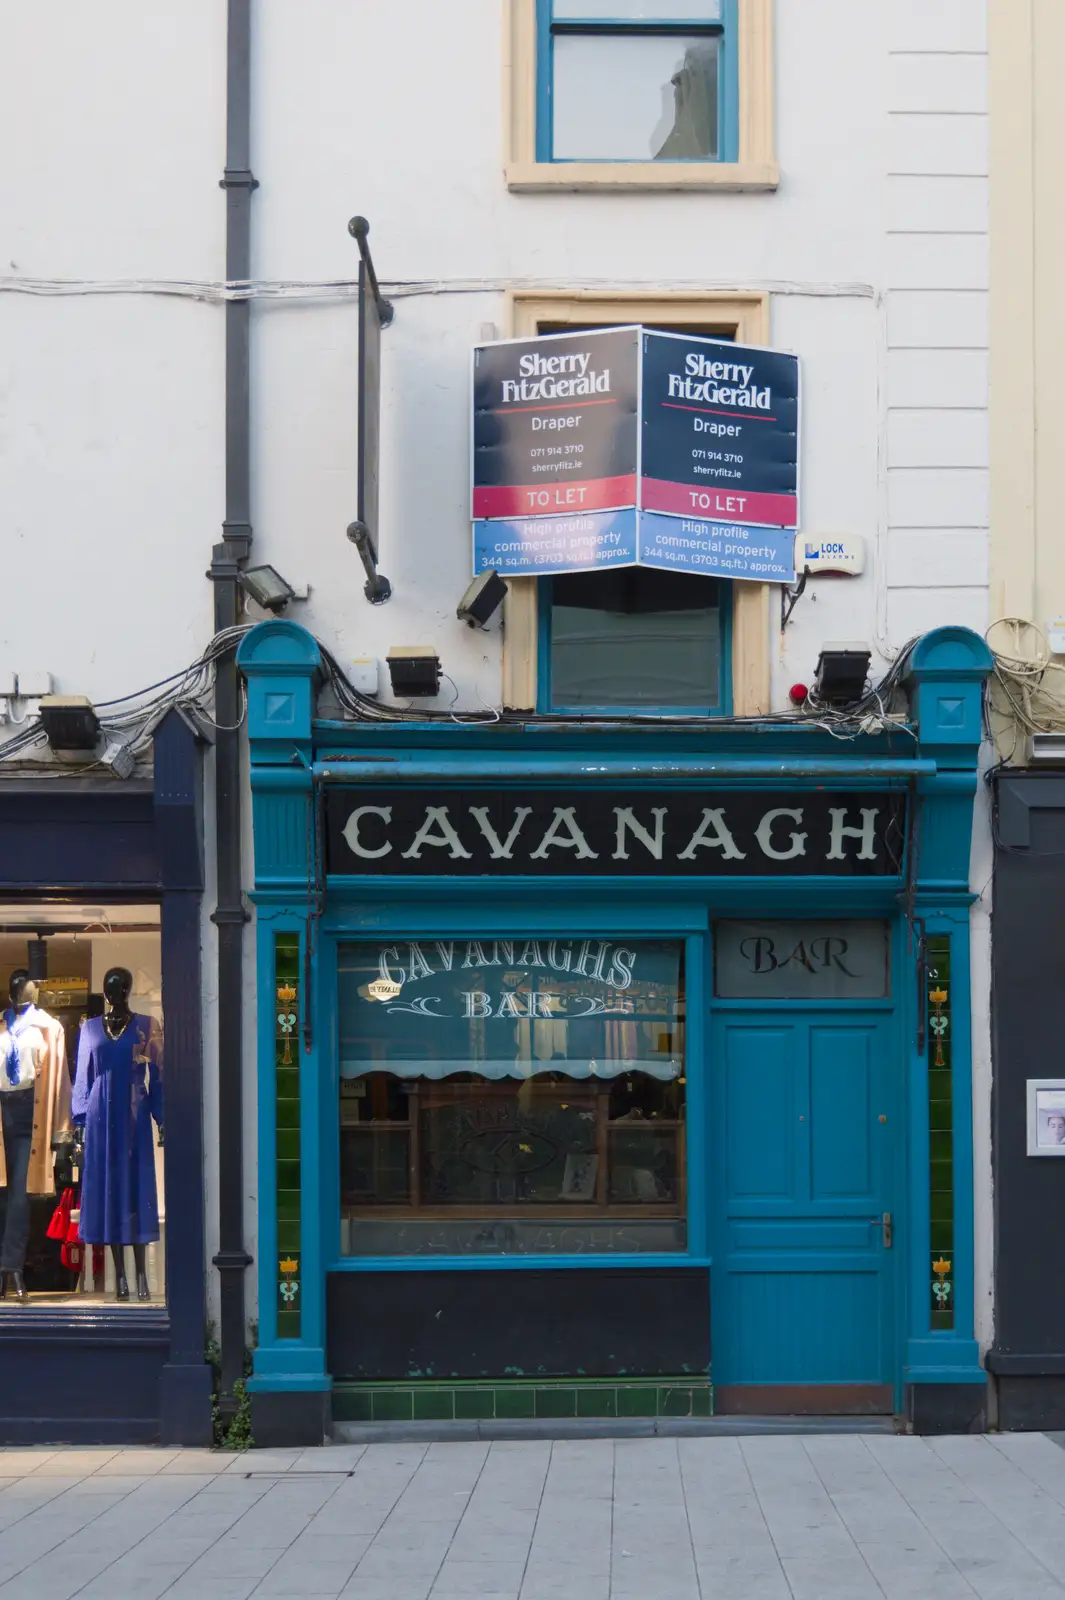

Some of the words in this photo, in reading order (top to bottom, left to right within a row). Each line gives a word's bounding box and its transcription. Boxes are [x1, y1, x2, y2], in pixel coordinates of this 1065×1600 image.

[519, 351, 592, 378] Sherry
[685, 352, 755, 389] Sherry
[501, 370, 611, 403] FitzGerald
[667, 373, 771, 410] FitzGerald
[531, 415, 582, 432] Draper
[693, 417, 742, 438] Draper
[530, 447, 546, 458] 071
[546, 446, 563, 457] 914
[563, 444, 584, 455] 3710
[691, 449, 707, 460] 071
[707, 450, 722, 461] 914
[723, 452, 743, 464] 3710
[531, 460, 582, 473] sherryfitz.ie
[693, 465, 742, 479] sherryfitz.ie
[527, 490, 550, 507] TO
[555, 487, 587, 505] LET
[689, 491, 710, 509] TO
[716, 495, 747, 513] LET
[523, 521, 552, 536] High
[555, 518, 595, 535] profile
[681, 520, 708, 538] High
[711, 524, 749, 540] profile
[494, 537, 567, 553] commercial
[569, 532, 621, 551] property
[655, 535, 722, 553] commercial
[725, 540, 776, 559] property
[821, 543, 844, 554] LOCK
[481, 556, 503, 567] 344
[505, 556, 532, 569] sq.m.
[534, 553, 564, 566] (3703
[596, 547, 630, 562] approx.
[644, 547, 663, 559] 344
[665, 551, 689, 566] sq.m.
[690, 553, 718, 567] (3703
[720, 557, 748, 571] sq.ft.)
[750, 562, 786, 574] approx.
[341, 805, 881, 860] CAVANAGH
[377, 941, 638, 990] CAVANAGHS
[740, 936, 863, 978] BAR
[461, 991, 555, 1019] BAR
